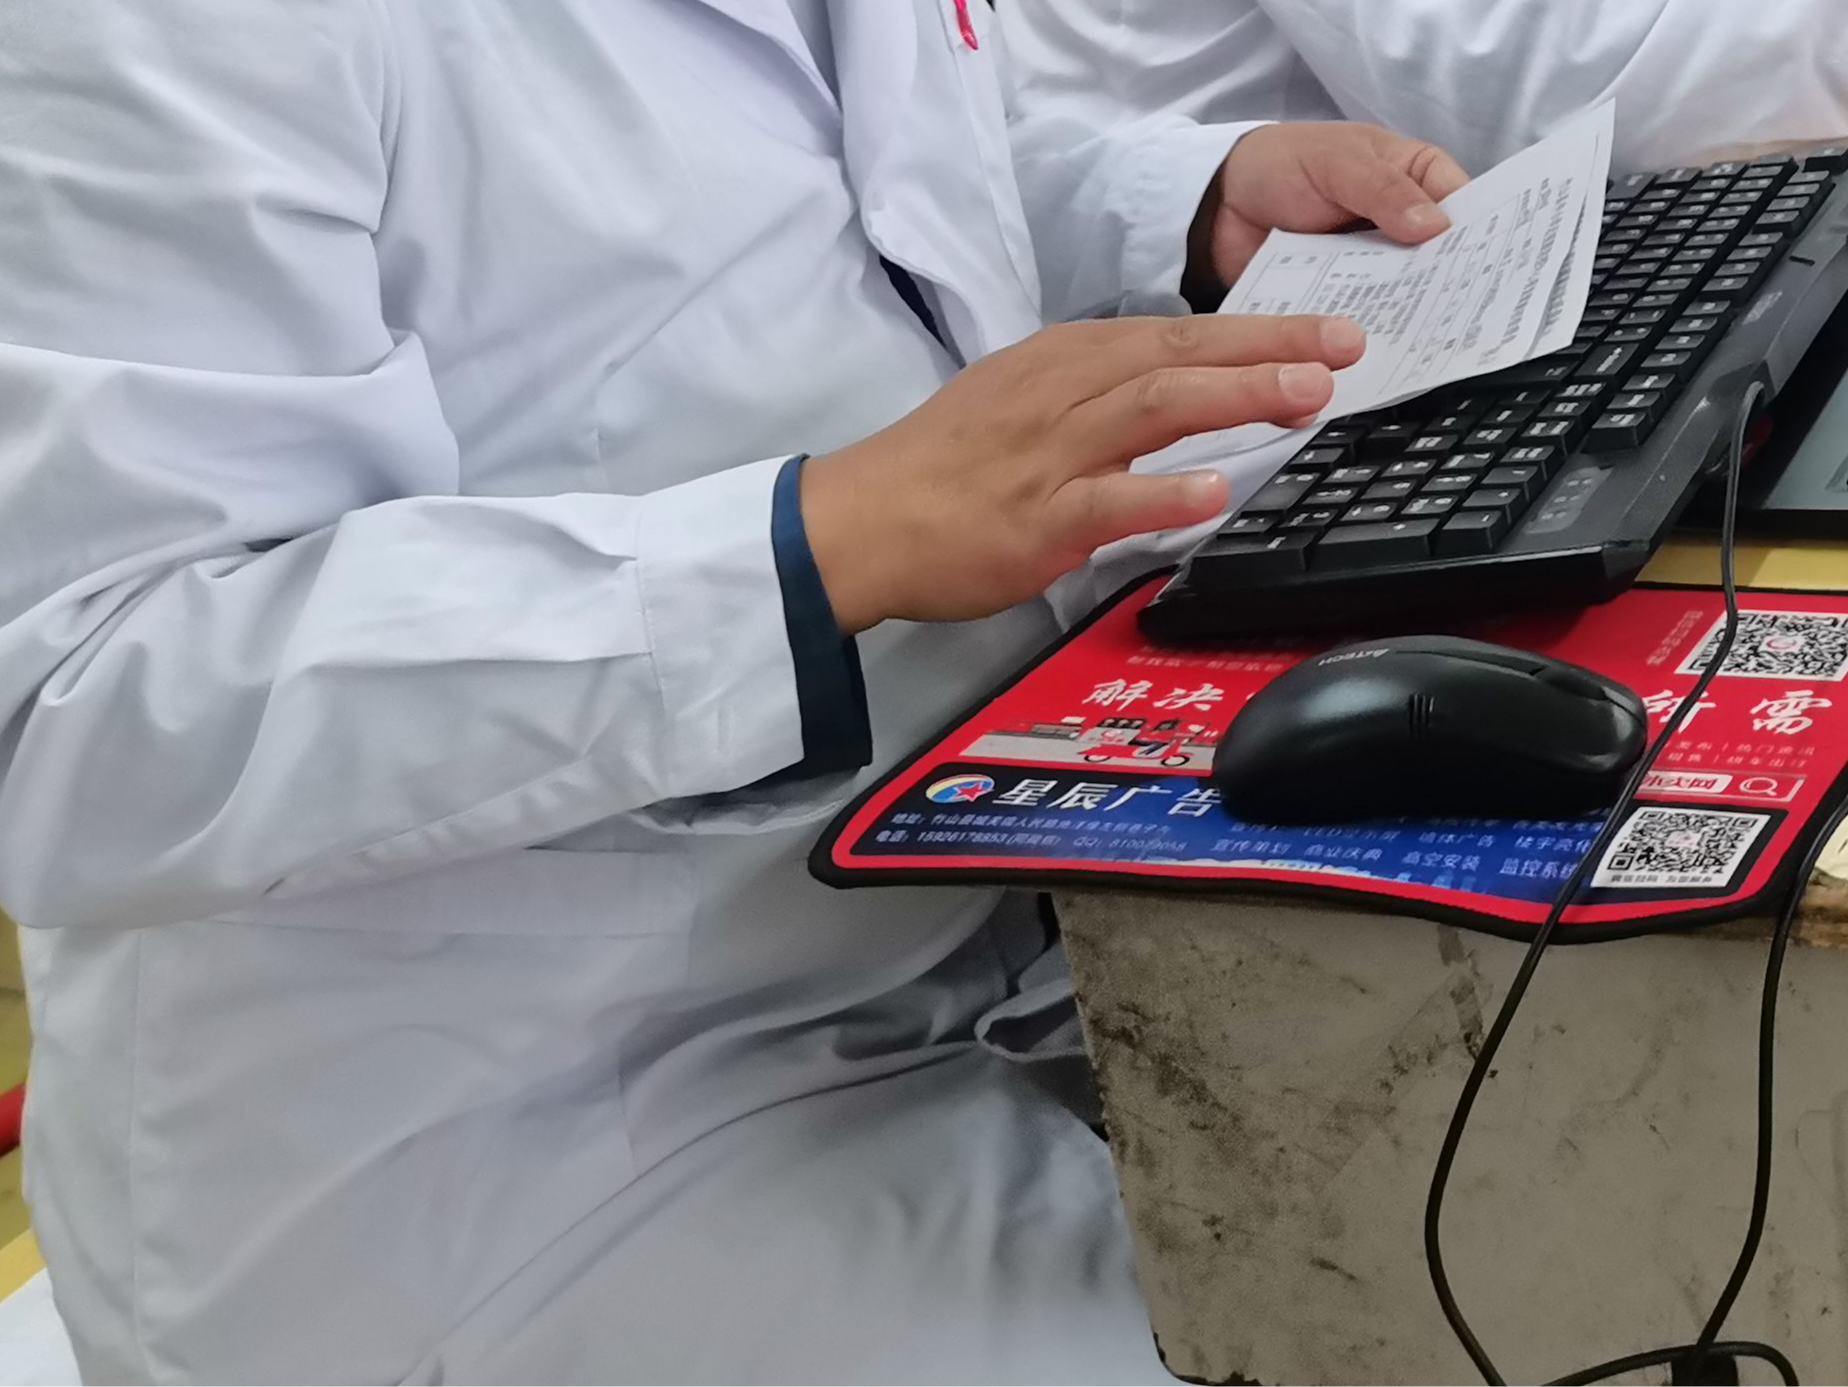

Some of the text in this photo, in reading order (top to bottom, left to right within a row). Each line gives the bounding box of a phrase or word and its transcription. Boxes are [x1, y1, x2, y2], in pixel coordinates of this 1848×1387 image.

[1081, 678, 1226, 712] 解决
[992, 777, 1223, 818] 星辰广告
[1303, 842, 1384, 862] 商业庆典
[1402, 850, 1481, 871] 高空安装
